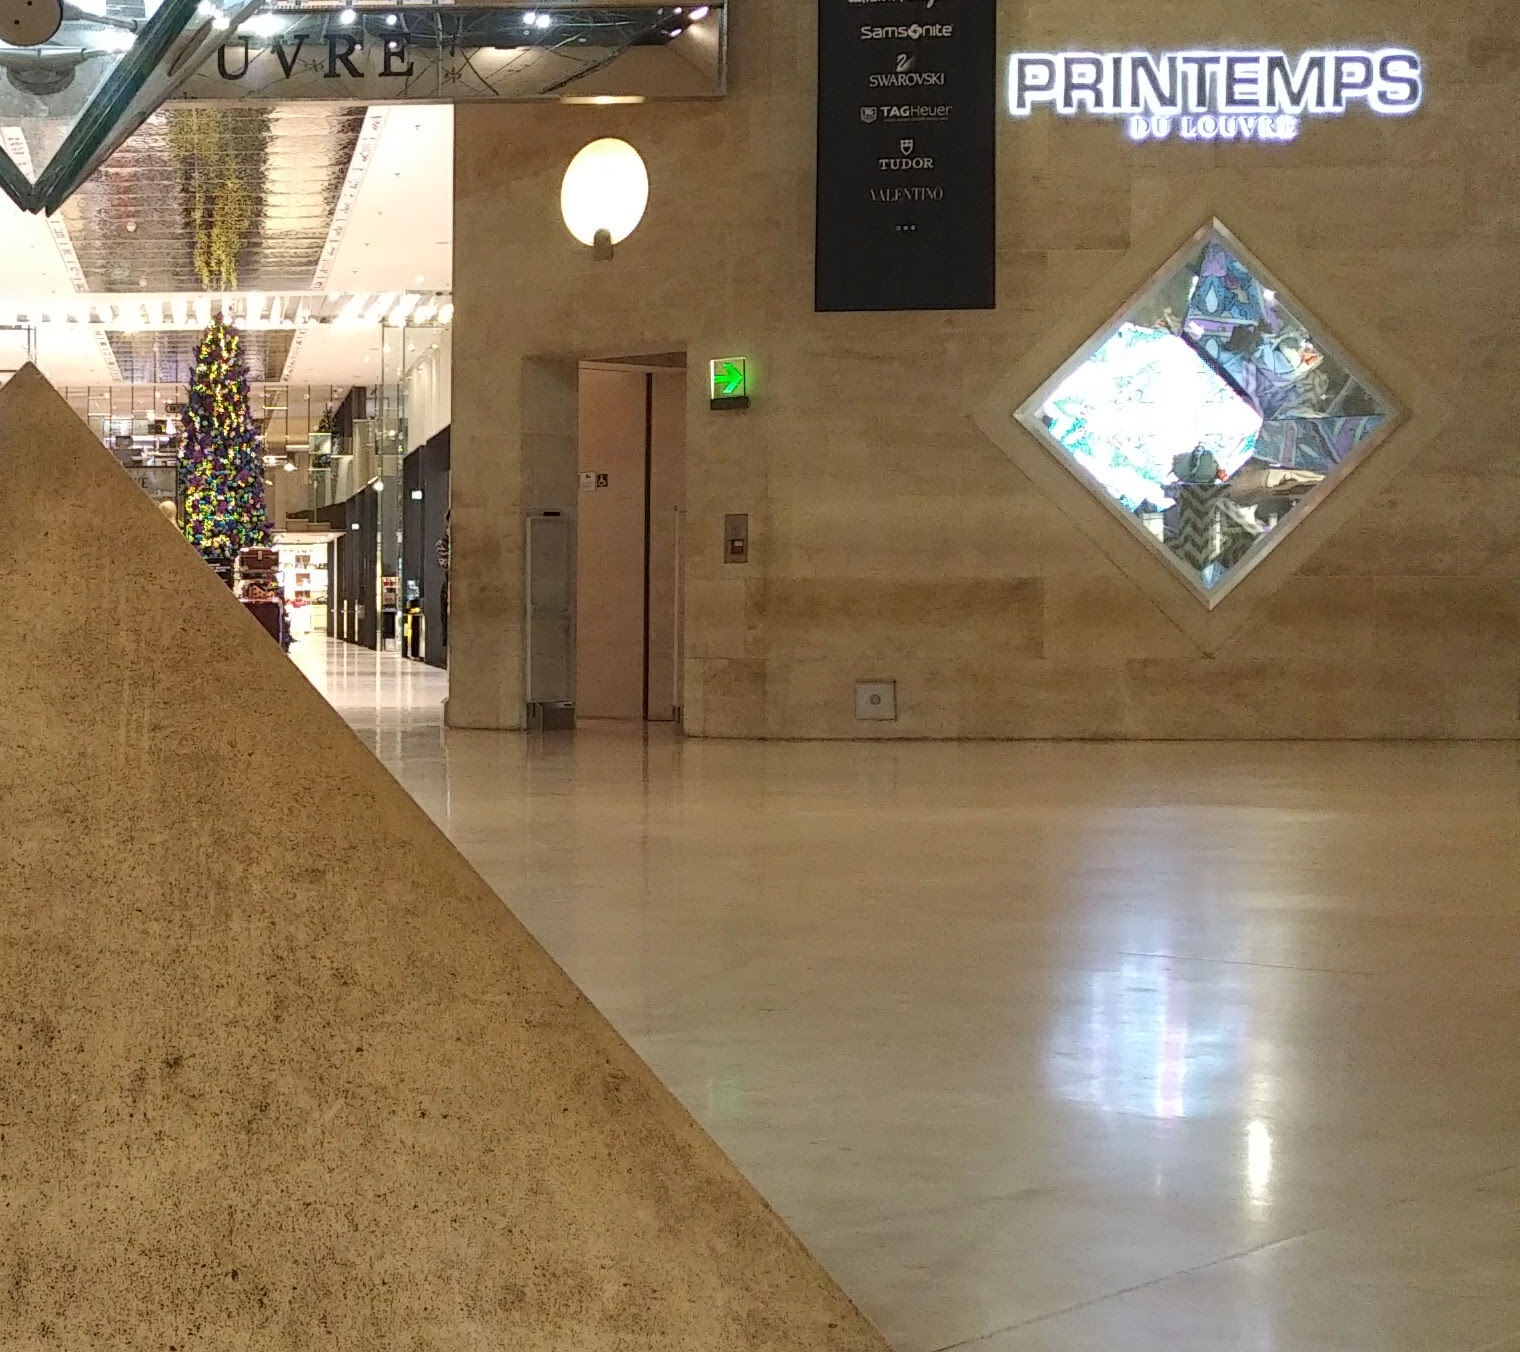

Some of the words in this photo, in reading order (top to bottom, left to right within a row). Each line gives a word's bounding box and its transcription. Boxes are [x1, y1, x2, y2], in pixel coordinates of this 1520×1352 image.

[860, 23, 953, 40] Samsonite
[869, 72, 945, 88] SWAROVSKI
[1011, 52, 1422, 115] PRINTEMPS
[1129, 116, 1172, 140] DU
[1181, 115, 1299, 139] LOUVRE
[879, 158, 934, 171] TUDOR
[869, 187, 944, 202] VALENTINO
